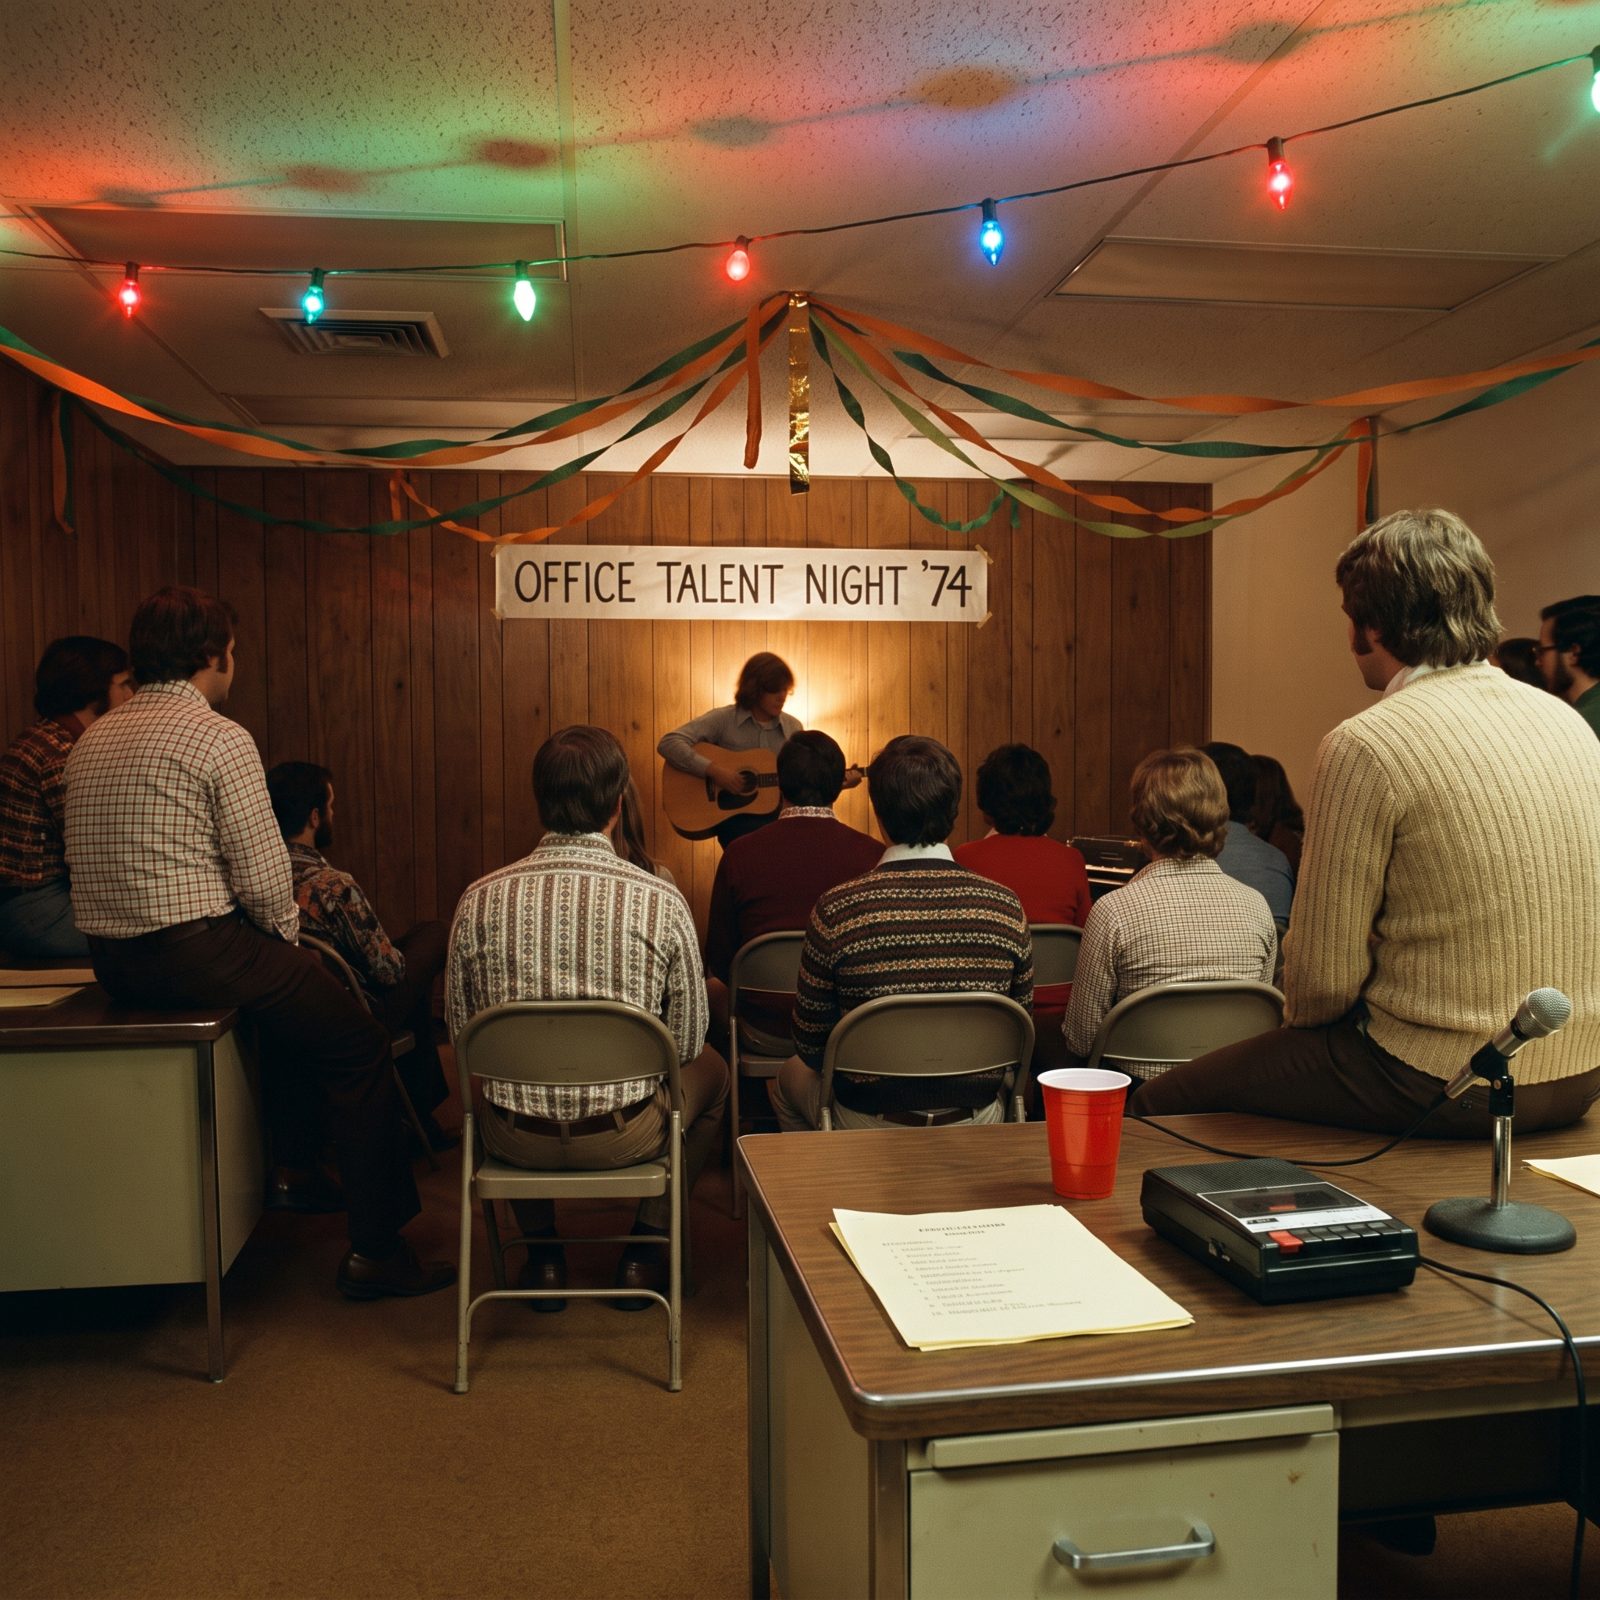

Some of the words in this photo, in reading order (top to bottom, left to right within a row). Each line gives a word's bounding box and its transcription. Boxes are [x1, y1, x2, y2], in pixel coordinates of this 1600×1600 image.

[514, 560, 636, 604] OFFICE
[656, 561, 784, 605] TALENT
[806, 564, 908, 607] NIGHT
[921, 559, 973, 608] '74
